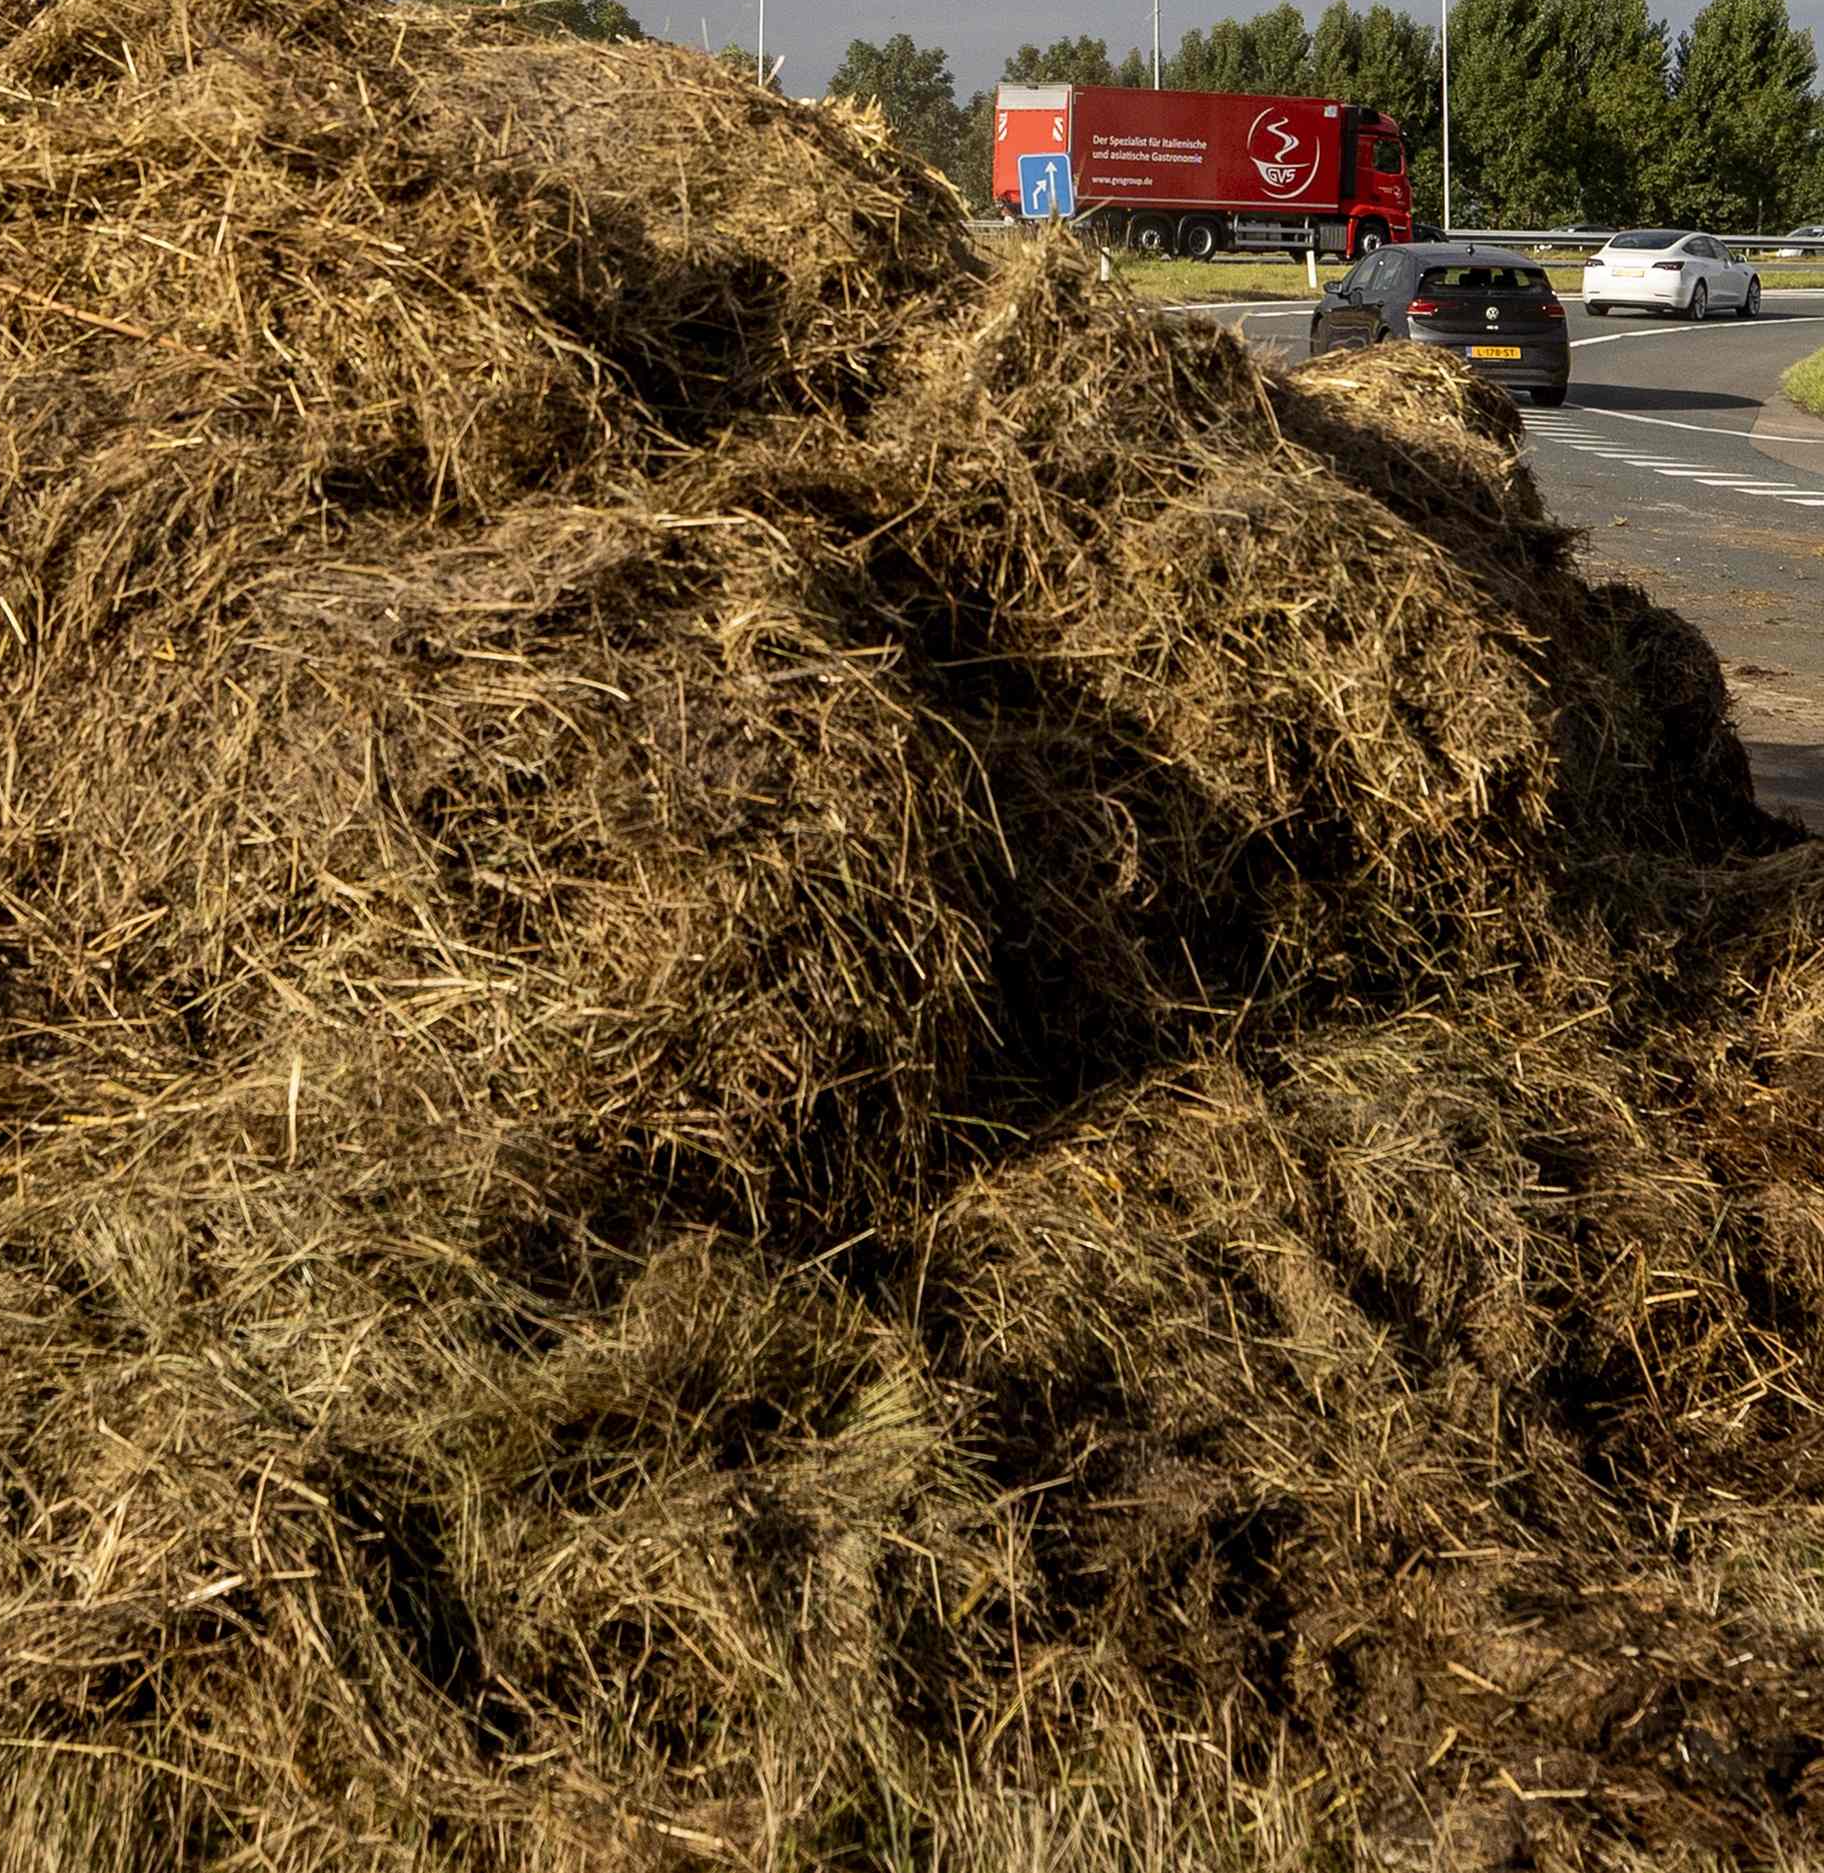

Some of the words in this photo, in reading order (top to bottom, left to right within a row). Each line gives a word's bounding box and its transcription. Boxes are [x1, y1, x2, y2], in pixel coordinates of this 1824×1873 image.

[1093, 134, 1108, 145] Der
[1109, 135, 1147, 147] Spezialist
[1149, 137, 1161, 147] für
[1092, 148, 1109, 159] und
[1110, 150, 1150, 161] asiatische
[1151, 151, 1202, 163] Gastronomie
[1268, 168, 1296, 183] GVS
